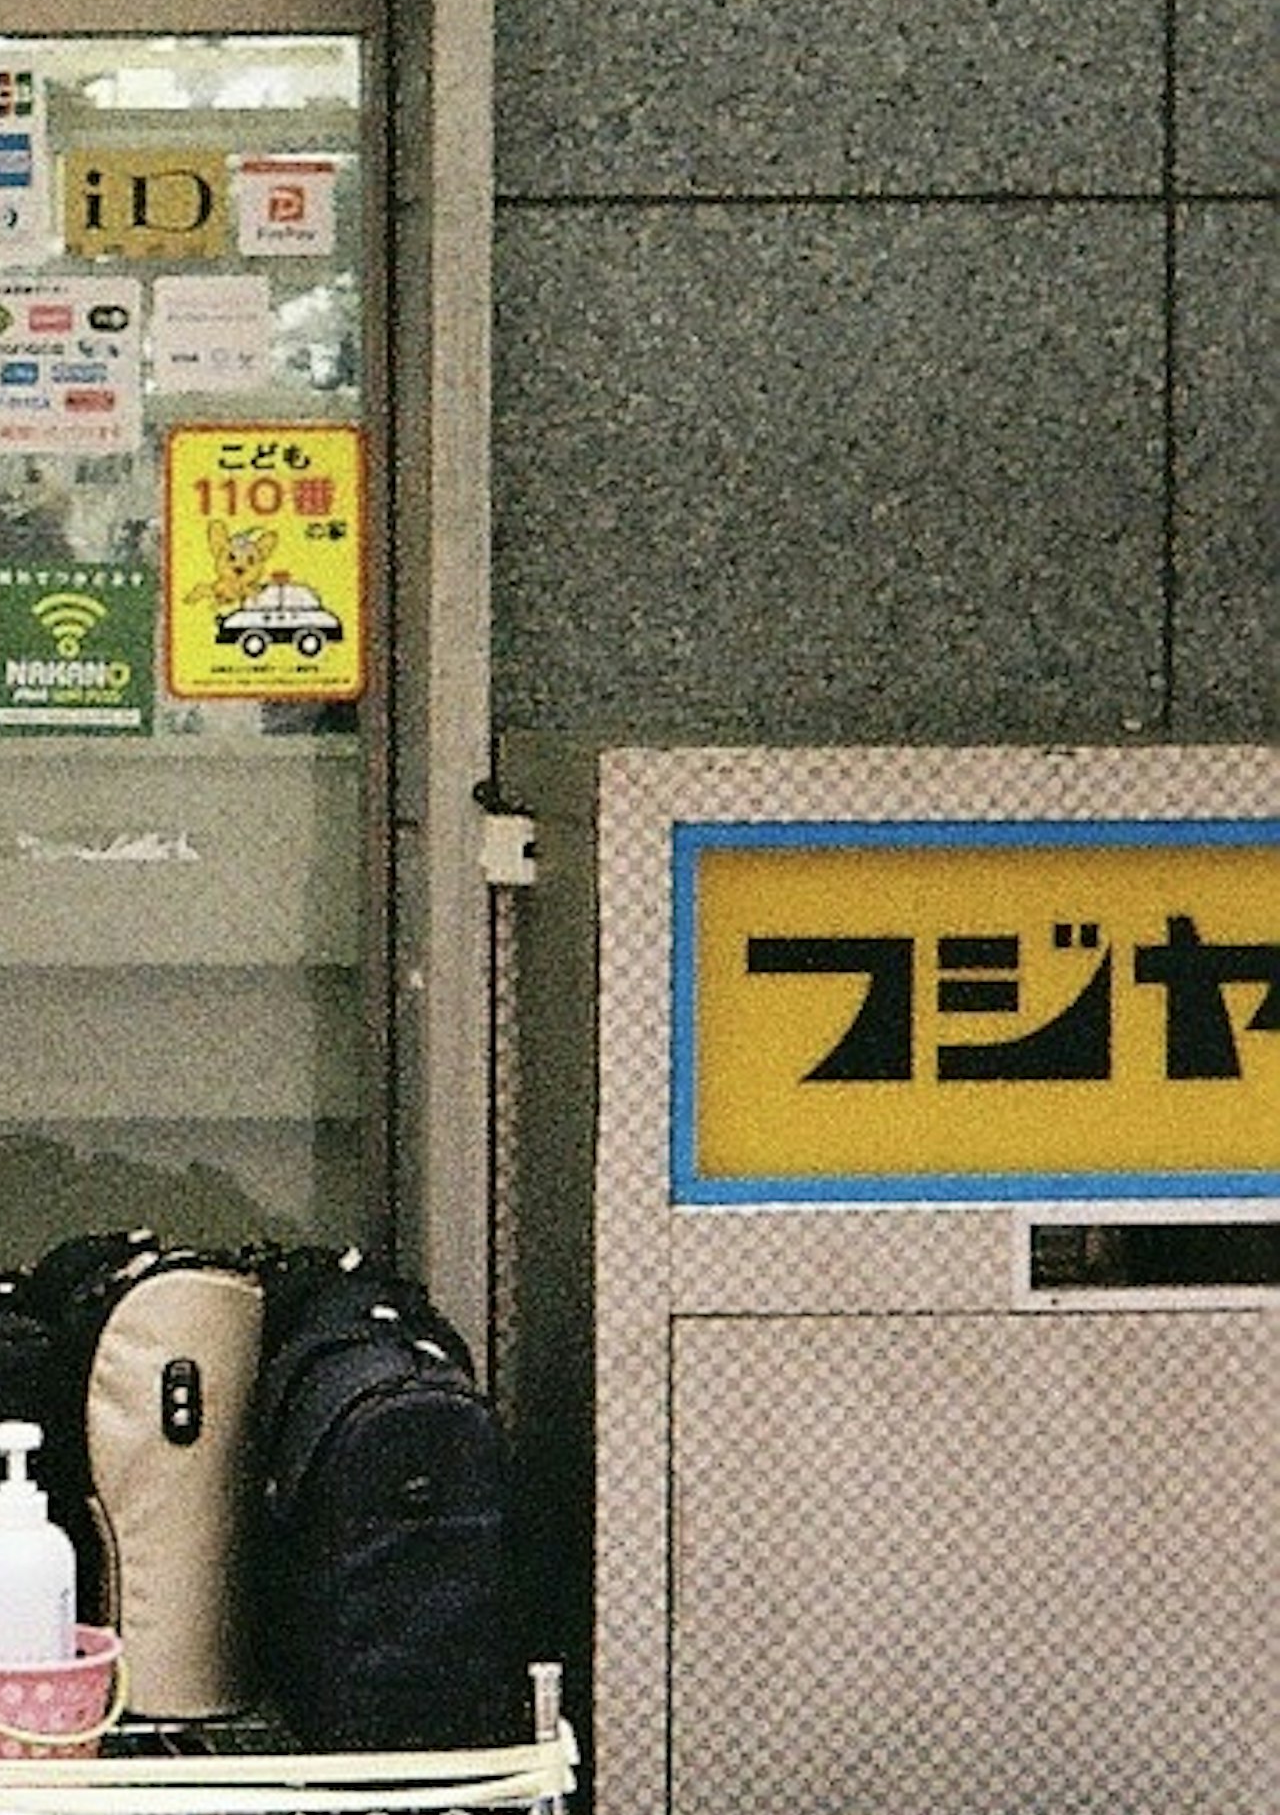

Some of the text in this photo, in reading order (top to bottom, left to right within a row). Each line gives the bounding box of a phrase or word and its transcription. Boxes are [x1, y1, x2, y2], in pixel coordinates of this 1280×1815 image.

[85, 169, 212, 233] iD
[218, 442, 311, 469] こども
[5, 660, 131, 689] NAKANO
[745, 916, 1280, 1082] フジヤ
